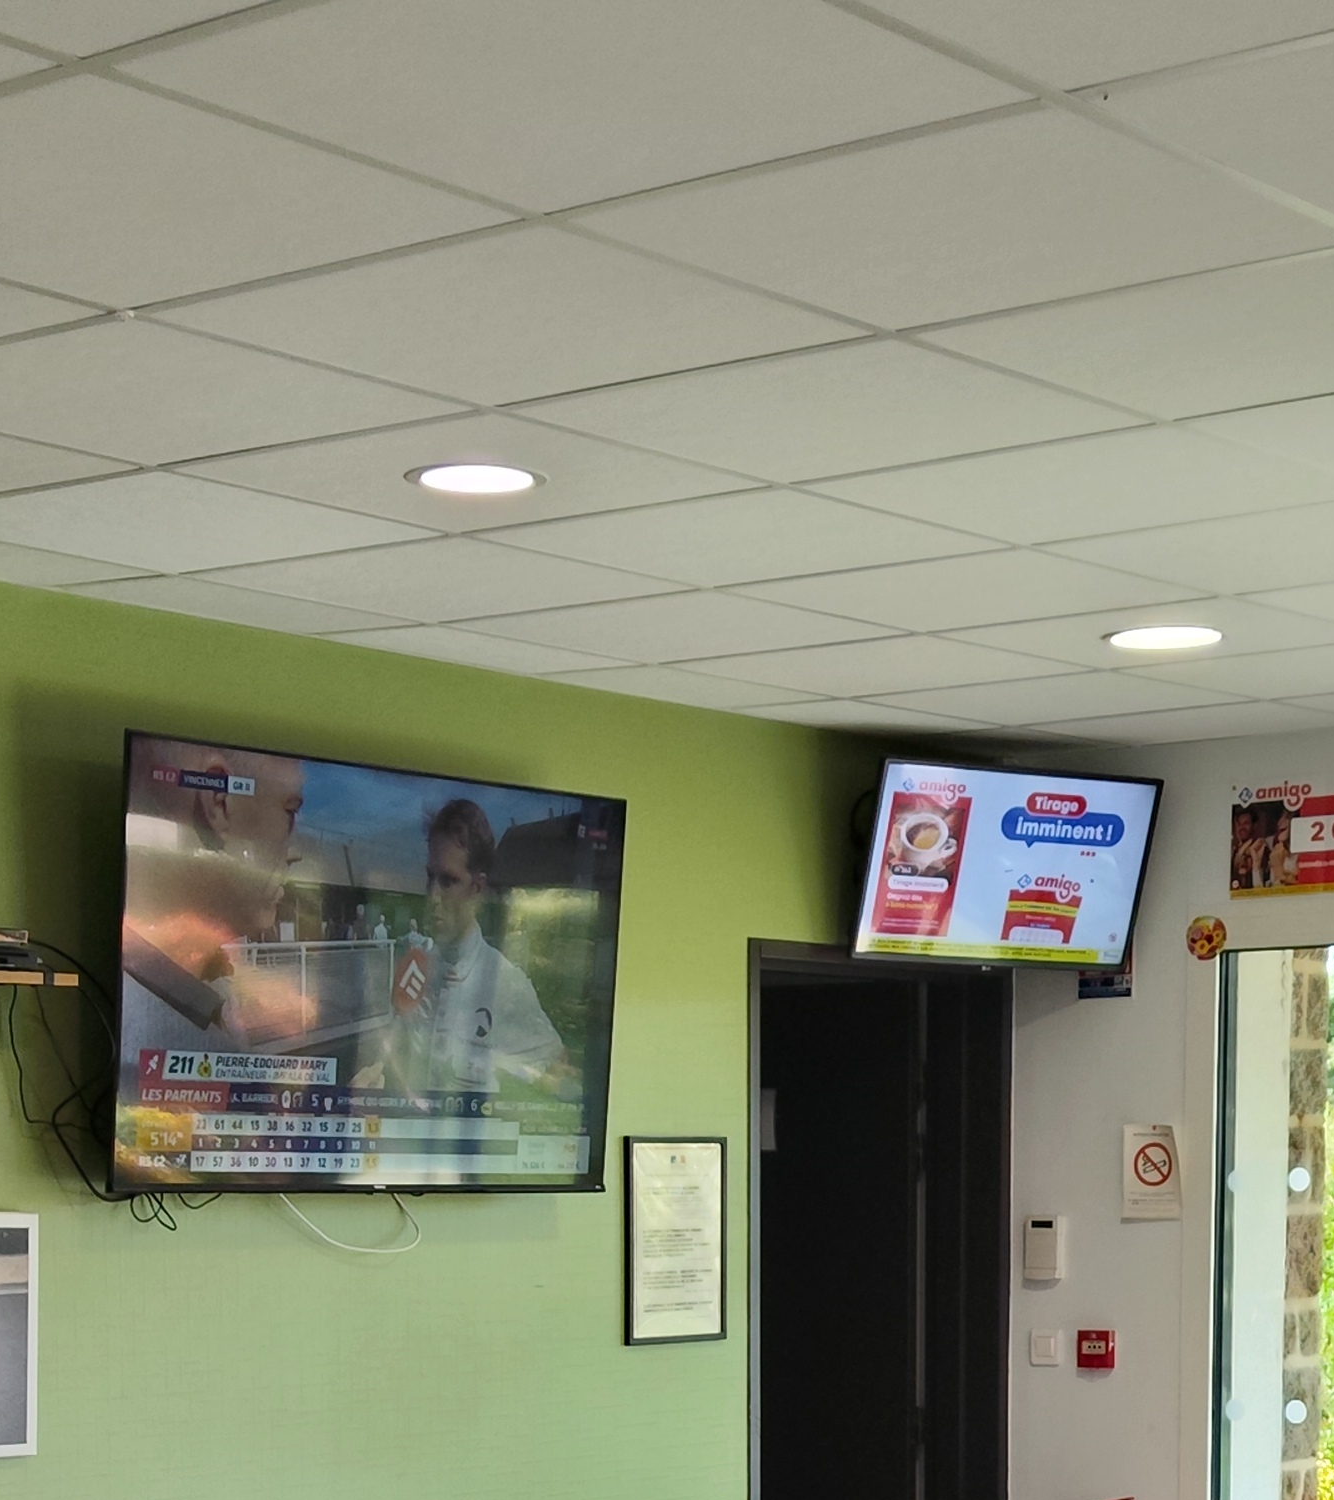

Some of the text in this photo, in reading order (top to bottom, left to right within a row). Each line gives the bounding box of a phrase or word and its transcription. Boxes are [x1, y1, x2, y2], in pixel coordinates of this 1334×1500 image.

[183, 774, 225, 789] VINCENNES
[919, 778, 967, 801] amigo
[1255, 780, 1312, 807] amigo
[1034, 796, 1079, 814] Tirage
[1016, 816, 1104, 841] imminent
[1034, 873, 1081, 900] amigo
[168, 1055, 195, 1075] 211
[215, 1055, 329, 1072] PIERRE-EDOUARD MARY
[141, 1087, 223, 1103] LES PARTANTS
[470, 1099, 478, 1112] 6
[214, 1119, 225, 1130] 61
[250, 1138, 258, 1149] 4
[196, 1156, 205, 1167] 17
